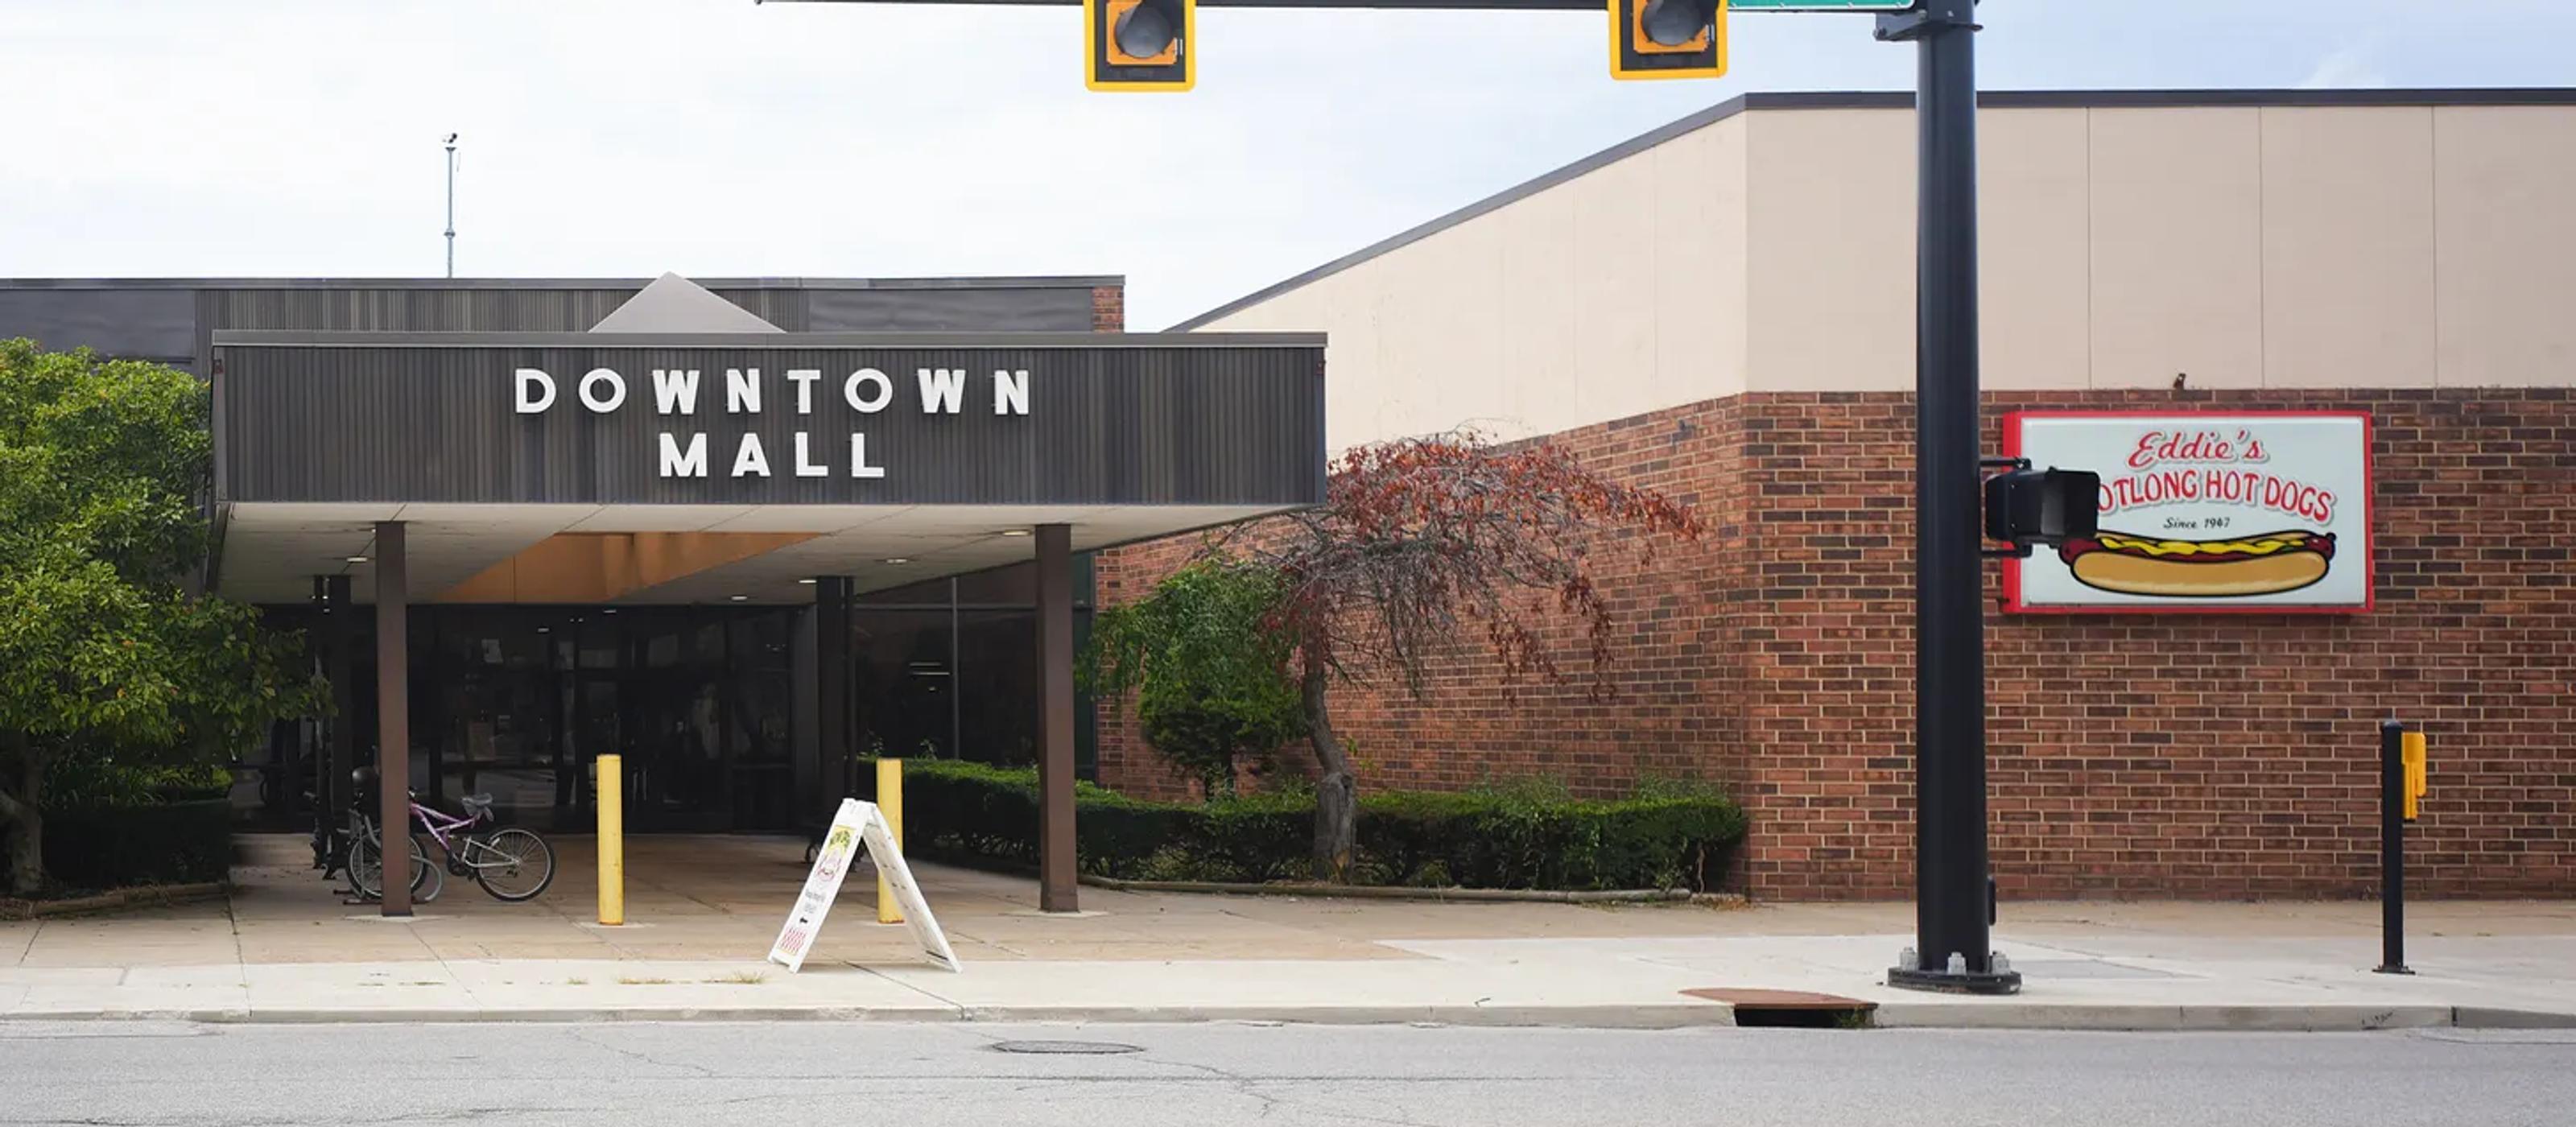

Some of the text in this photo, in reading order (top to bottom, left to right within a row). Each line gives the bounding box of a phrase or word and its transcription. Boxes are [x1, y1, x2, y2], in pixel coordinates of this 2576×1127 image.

[515, 368, 1029, 414] DOWNTOWN
[659, 432, 885, 477] MALL
[2128, 430, 2265, 468] Eddie's
[2099, 469, 2331, 522] OTLONG HOT DOGS
[2163, 517, 2197, 529] Since
